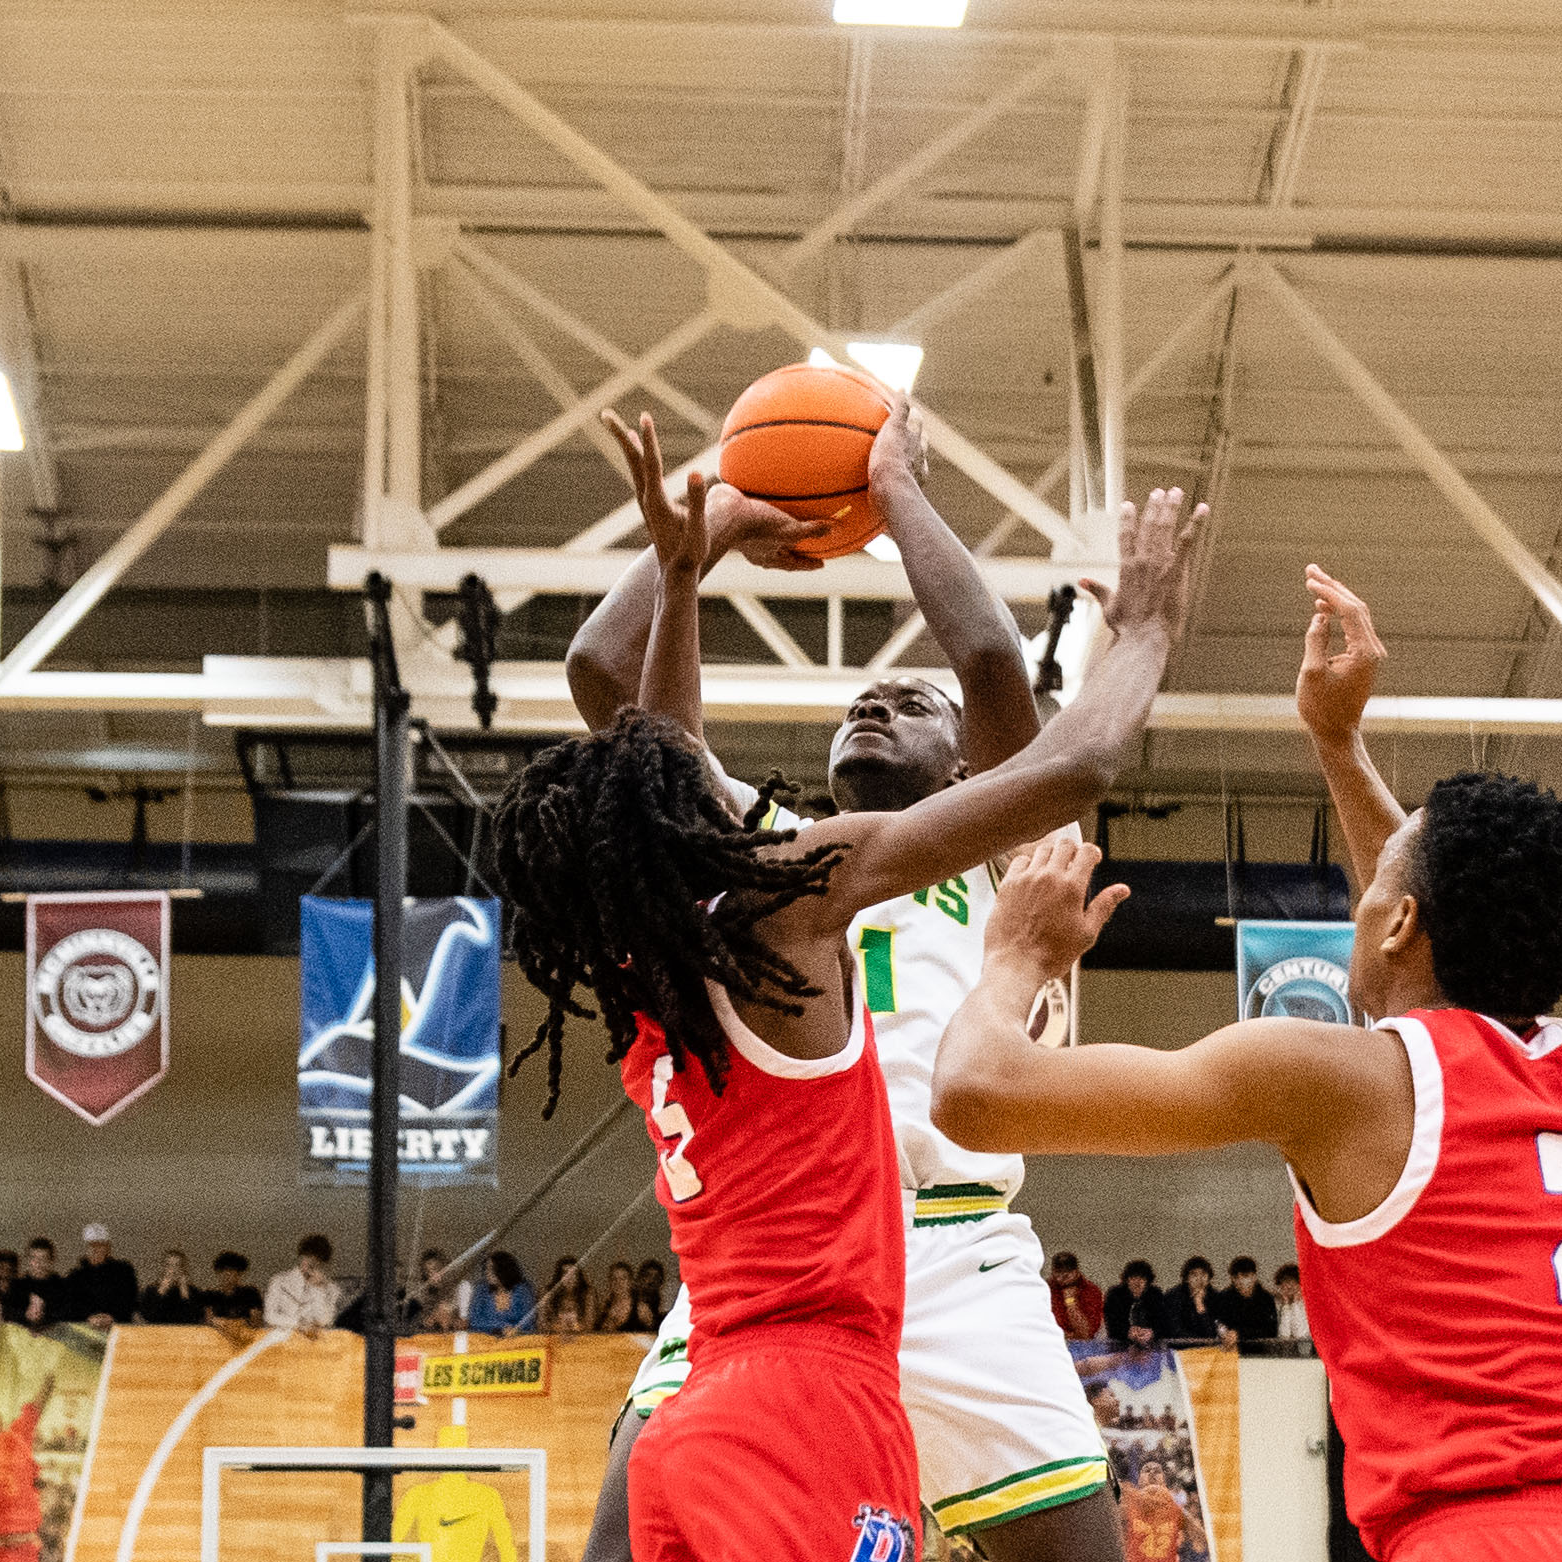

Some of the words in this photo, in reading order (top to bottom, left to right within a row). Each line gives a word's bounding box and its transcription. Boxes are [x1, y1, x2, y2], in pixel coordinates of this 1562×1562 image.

[1258, 960, 1350, 995] CENTUR
[310, 1126, 489, 1160] LIRTY
[422, 1363, 454, 1388] LES
[458, 1358, 542, 1386] SCHWAB
